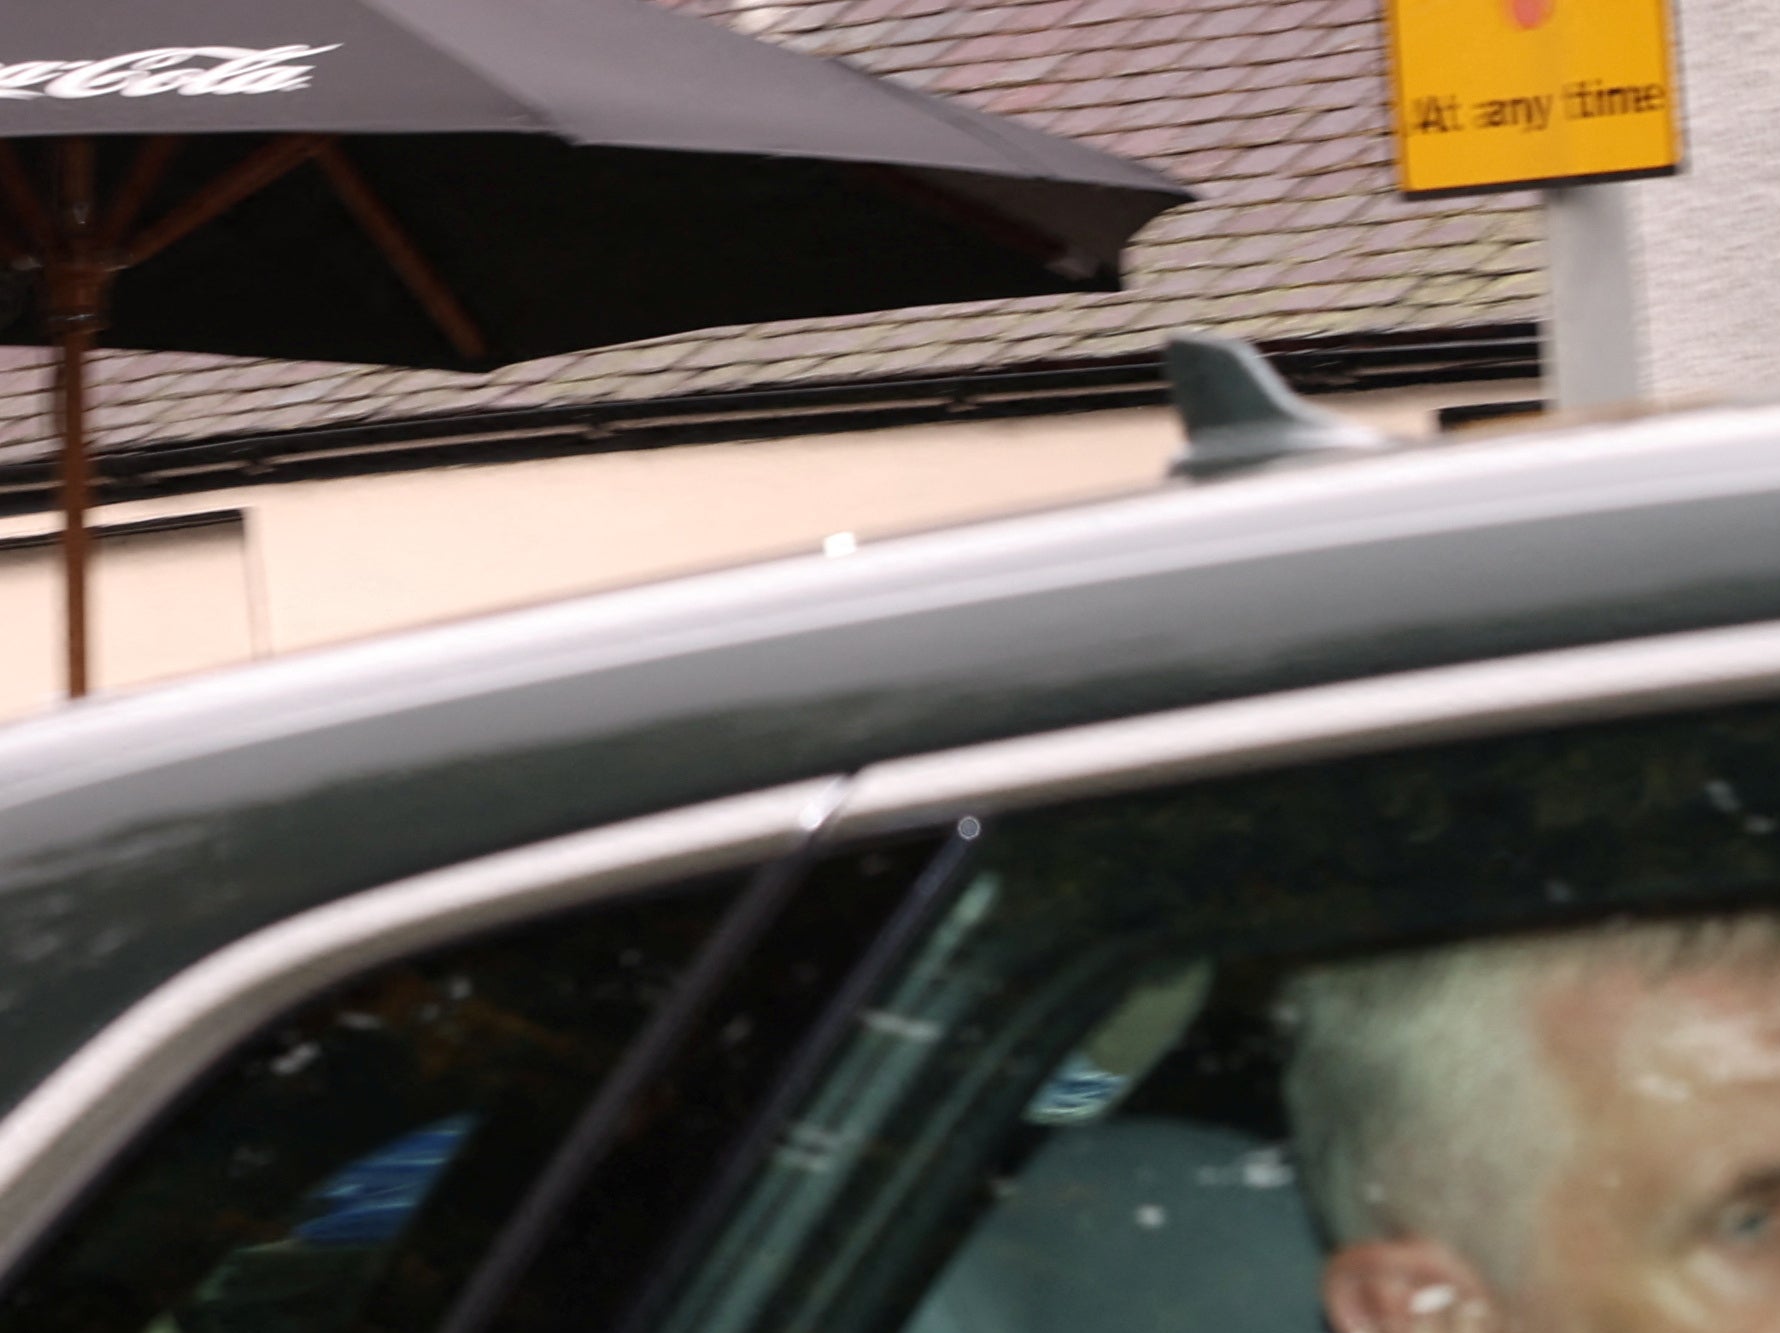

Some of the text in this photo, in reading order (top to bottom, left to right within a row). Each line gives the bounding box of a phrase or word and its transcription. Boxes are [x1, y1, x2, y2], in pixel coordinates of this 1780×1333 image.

[0, 42, 345, 100] a-Cola
[1411, 78, 1666, 134] At any time
